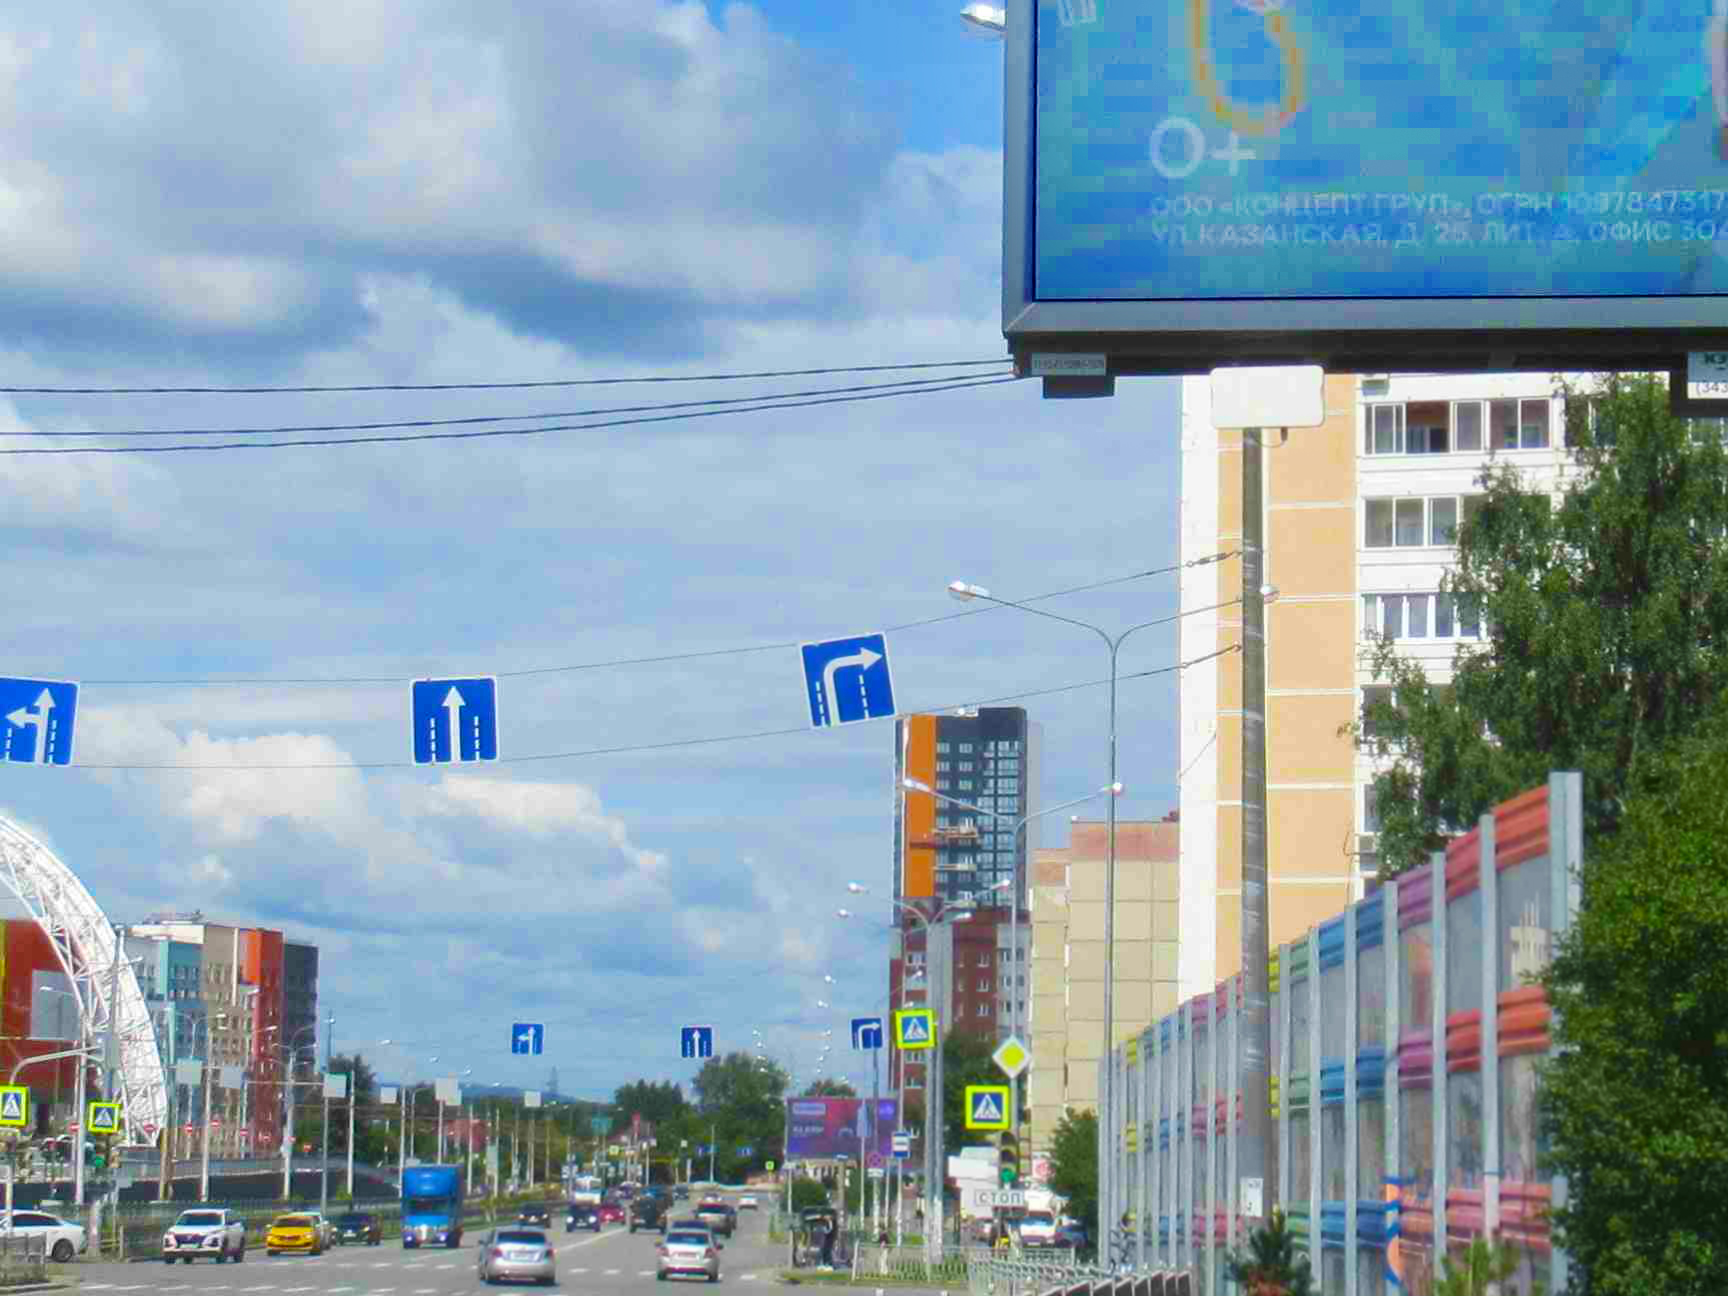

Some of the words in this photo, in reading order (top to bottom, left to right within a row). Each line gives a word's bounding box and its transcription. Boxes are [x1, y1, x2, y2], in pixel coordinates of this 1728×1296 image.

[1148, 115, 1258, 180] 0+
[1150, 192, 1213, 216] ООО
[1589, 220, 1673, 243] ОФИС
[978, 1190, 1021, 1204] СТОП
